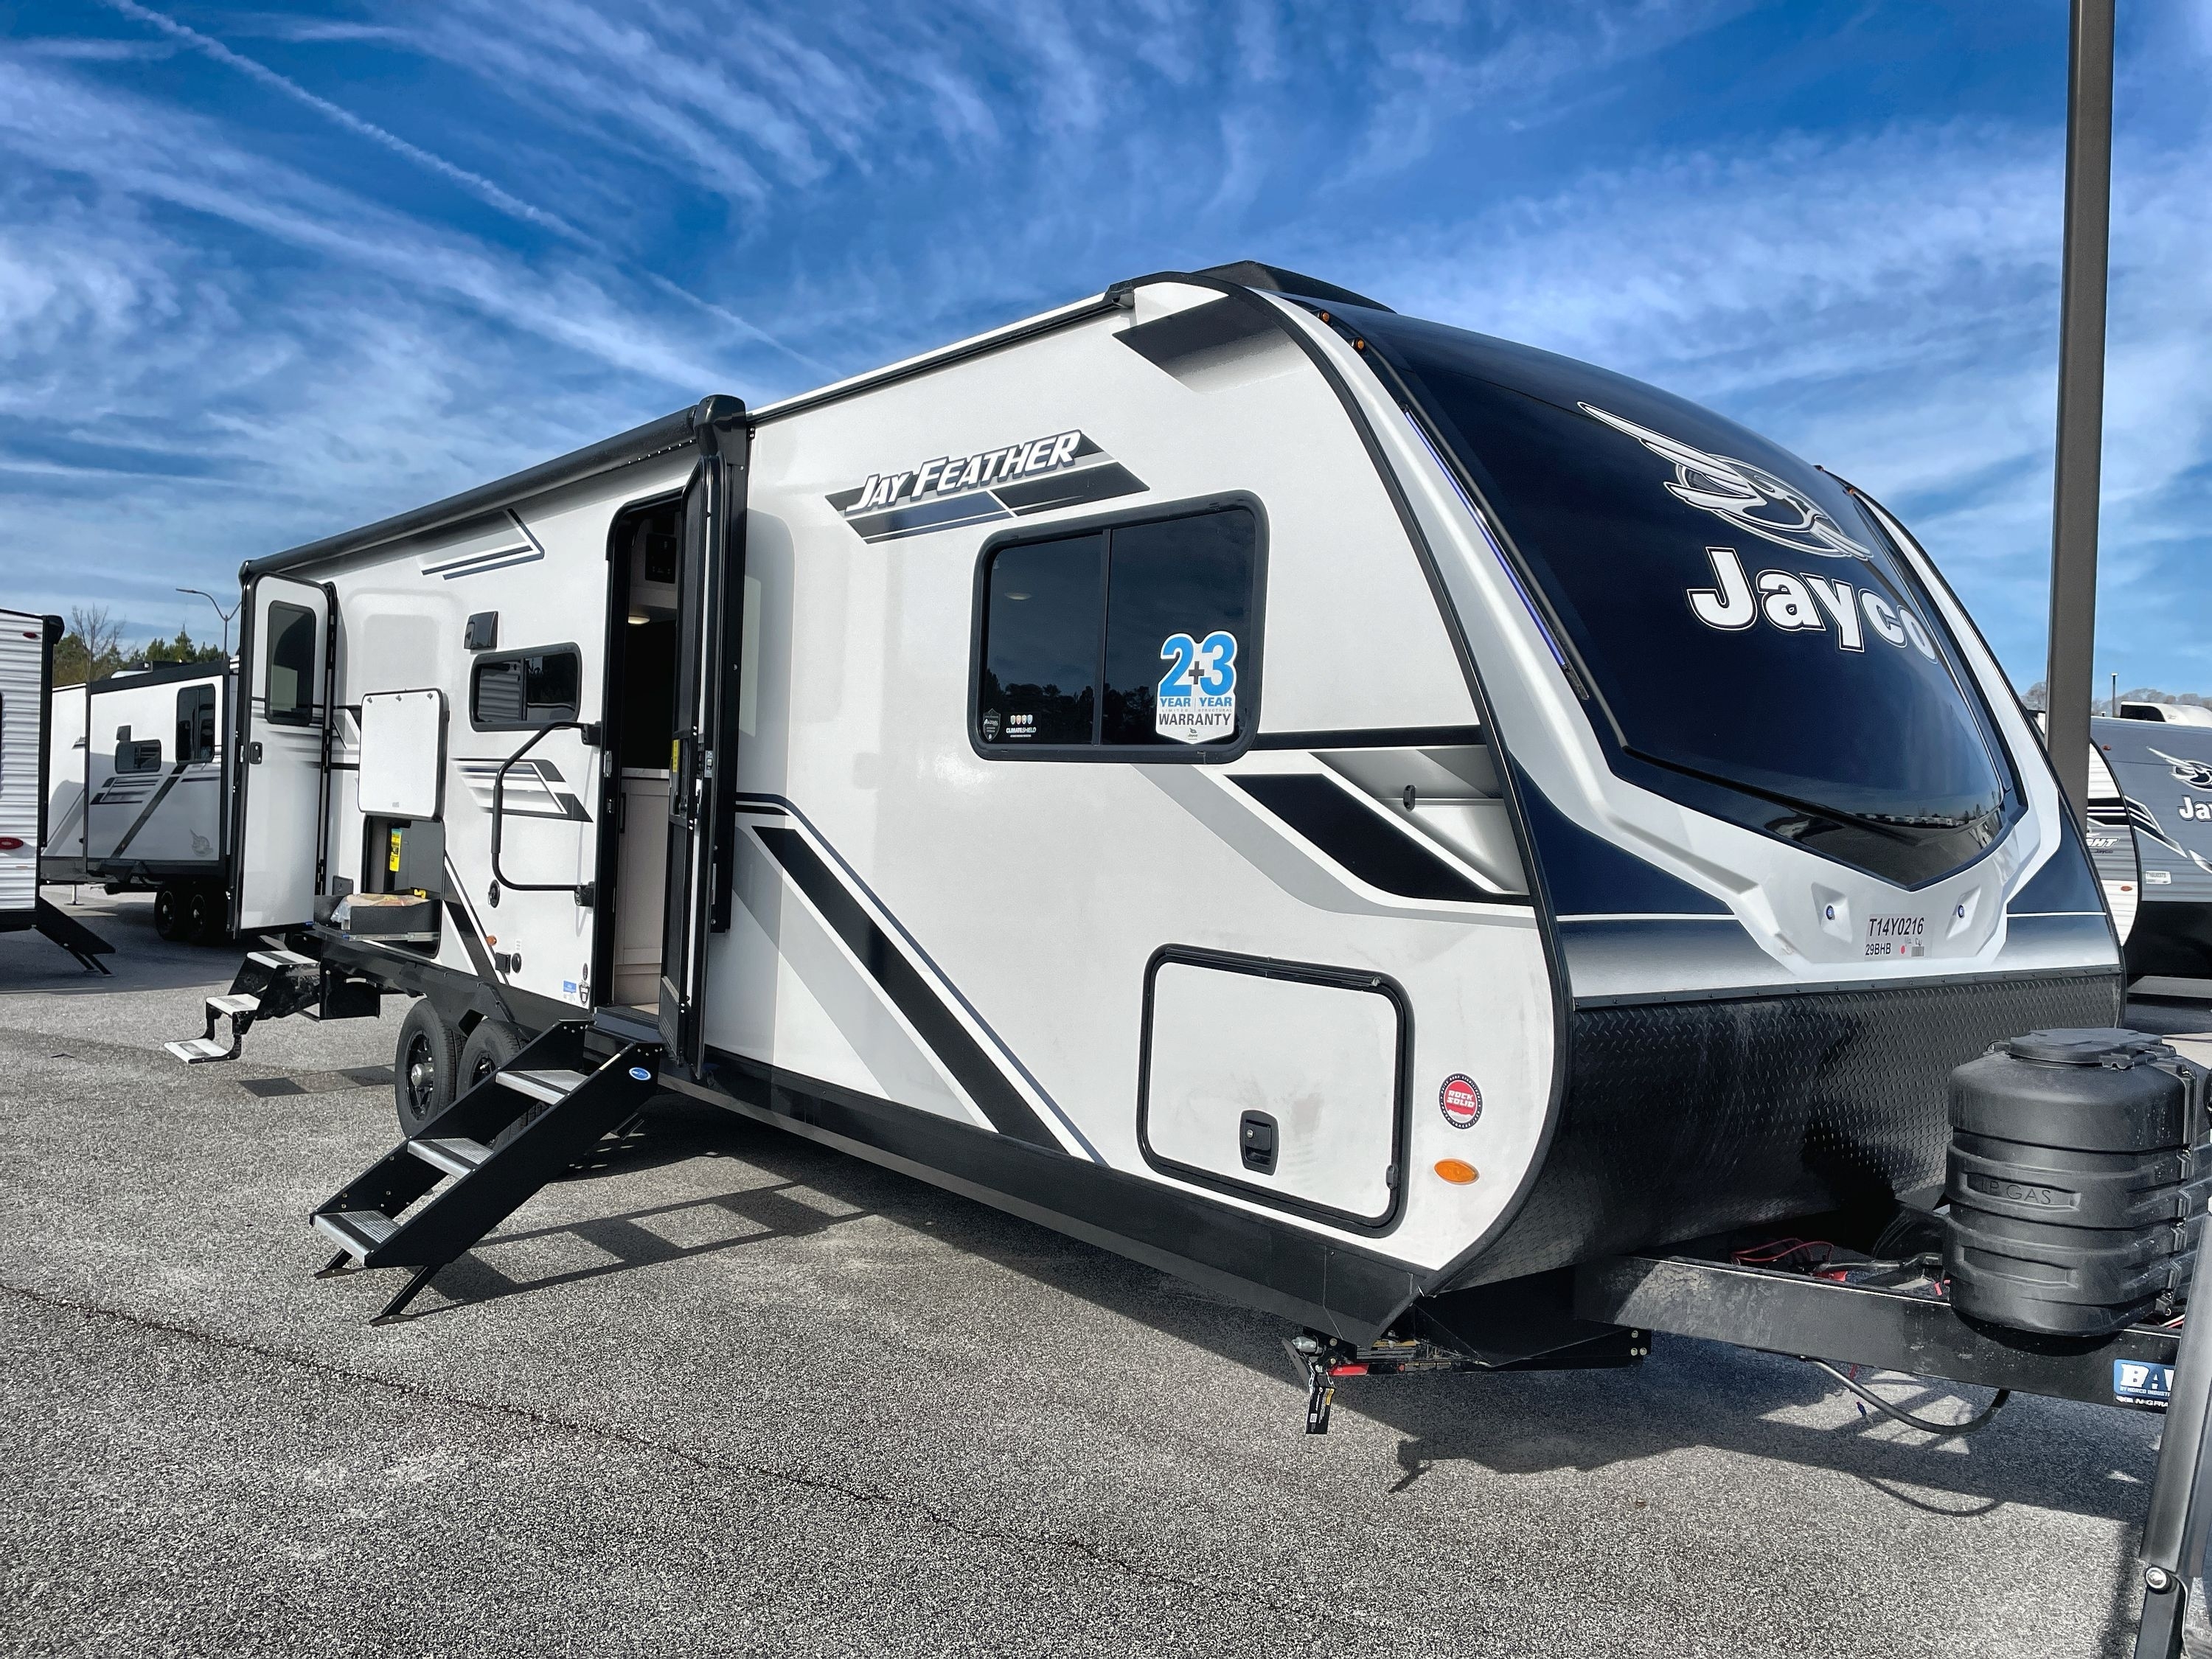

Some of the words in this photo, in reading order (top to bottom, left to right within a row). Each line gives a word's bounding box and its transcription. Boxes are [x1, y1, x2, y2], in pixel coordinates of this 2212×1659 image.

[845, 471, 913, 515] JAY
[911, 429, 1082, 501] FEATHER
[1687, 546, 1938, 664] Jayco
[1160, 698, 1191, 707] YEAR
[1199, 697, 1232, 707] YEAR
[1159, 713, 1231, 726] WARRANTY
[2177, 795, 2212, 822] Ja
[1869, 917, 1924, 936] T14Y0216
[1865, 942, 1891, 956] 29BHB
[1447, 1096, 1475, 1108] SOLID
[1448, 1090, 1473, 1100] ROCK
[1980, 1178, 2000, 1193] LP
[2006, 1184, 2051, 1205] GAS
